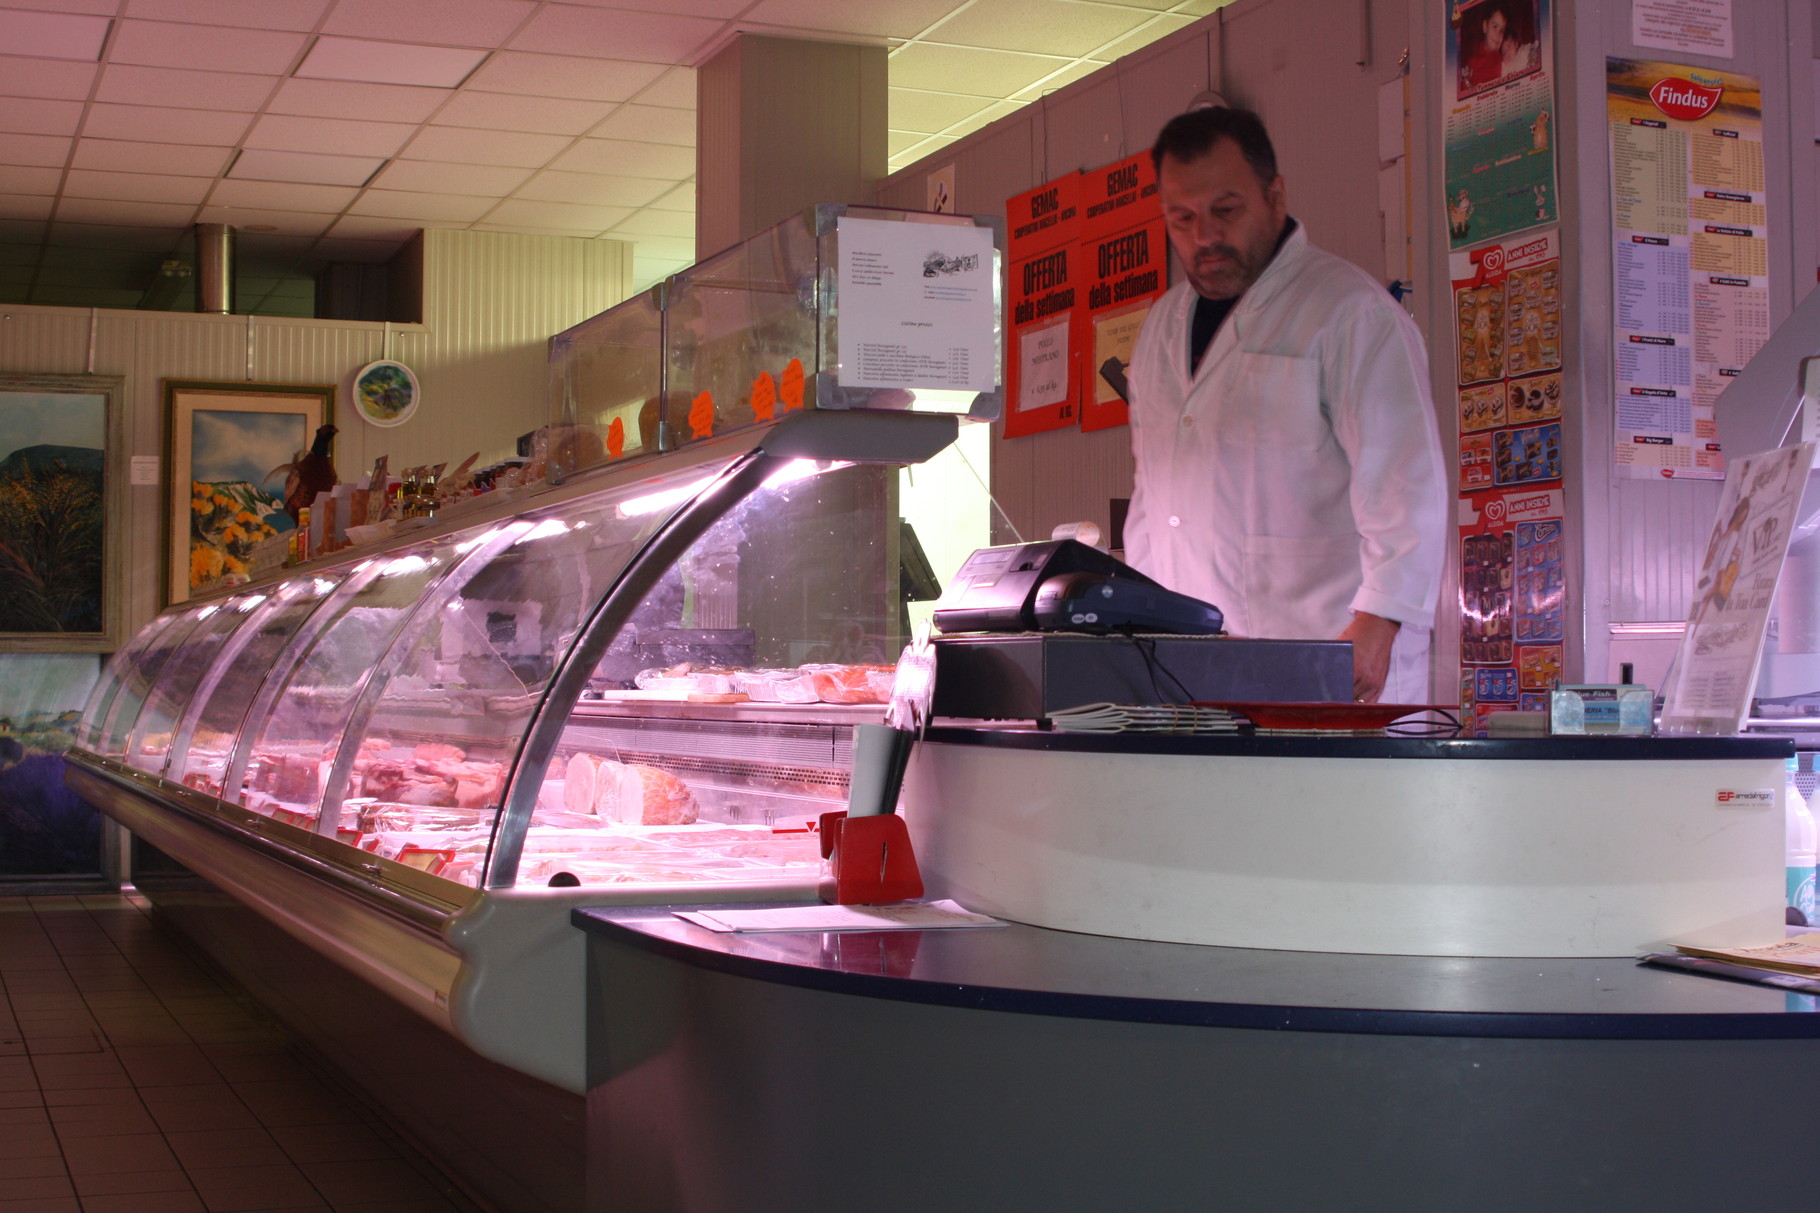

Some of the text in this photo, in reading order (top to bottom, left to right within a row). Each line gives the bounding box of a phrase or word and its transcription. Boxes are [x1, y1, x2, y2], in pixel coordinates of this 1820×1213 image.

[1659, 86, 1709, 108] Findus
[1023, 250, 1068, 296] OFFERTA
[1098, 229, 1149, 279] OFFERTA
[1015, 287, 1075, 326] della settimana
[1089, 269, 1159, 311] della settimana
[1593, 690, 1611, 698] Fish
